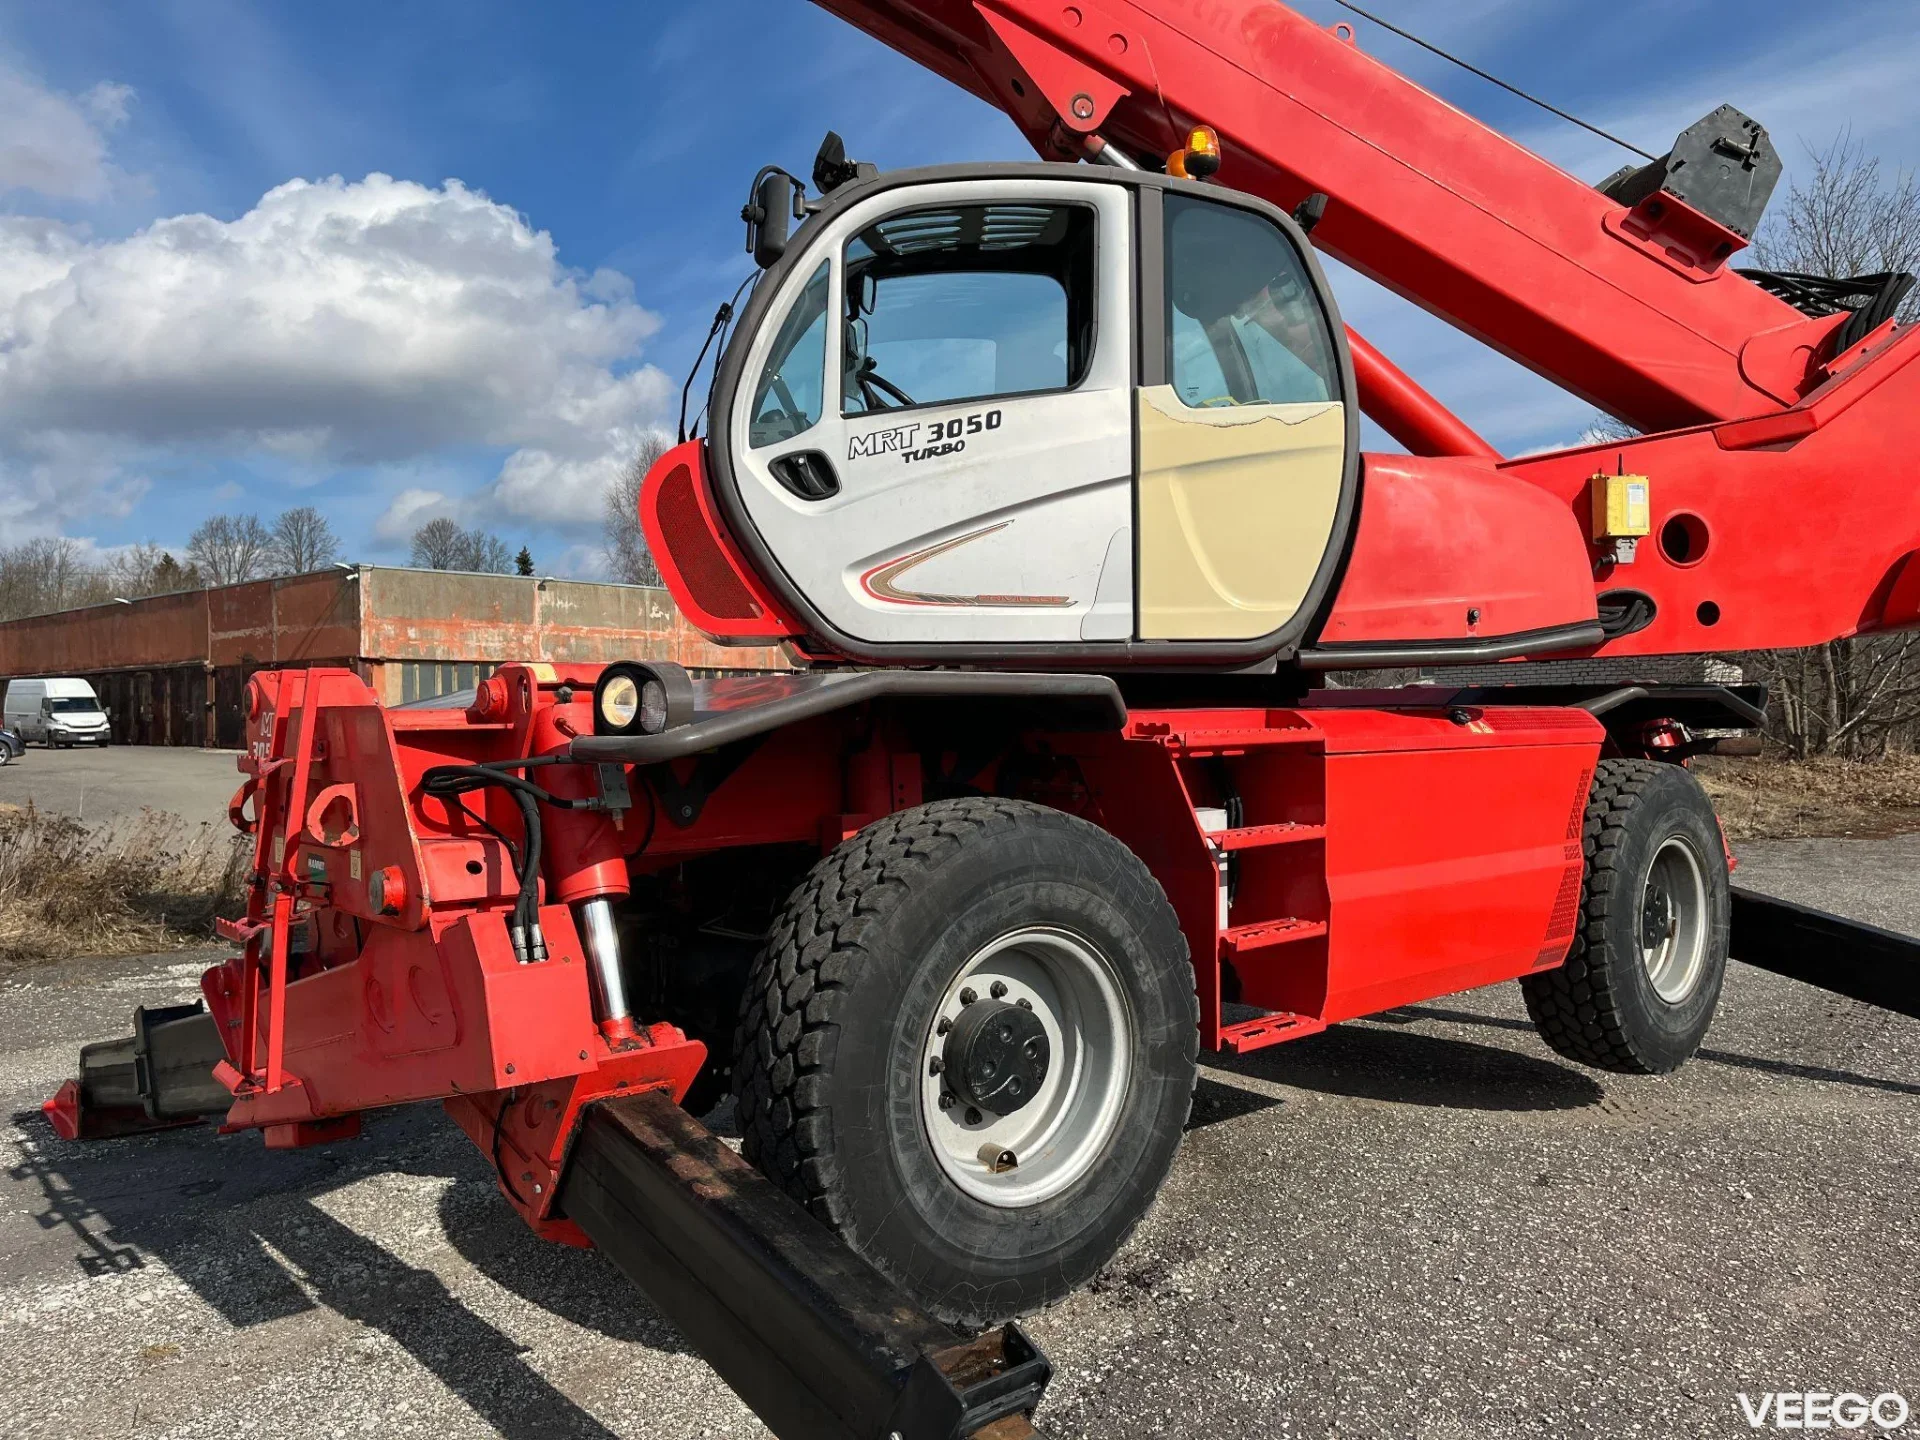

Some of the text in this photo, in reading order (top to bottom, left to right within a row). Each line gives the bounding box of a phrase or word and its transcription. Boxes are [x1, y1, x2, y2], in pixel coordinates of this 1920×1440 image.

[848, 409, 1002, 460] MRT 3050
[901, 439, 966, 464] TURBO
